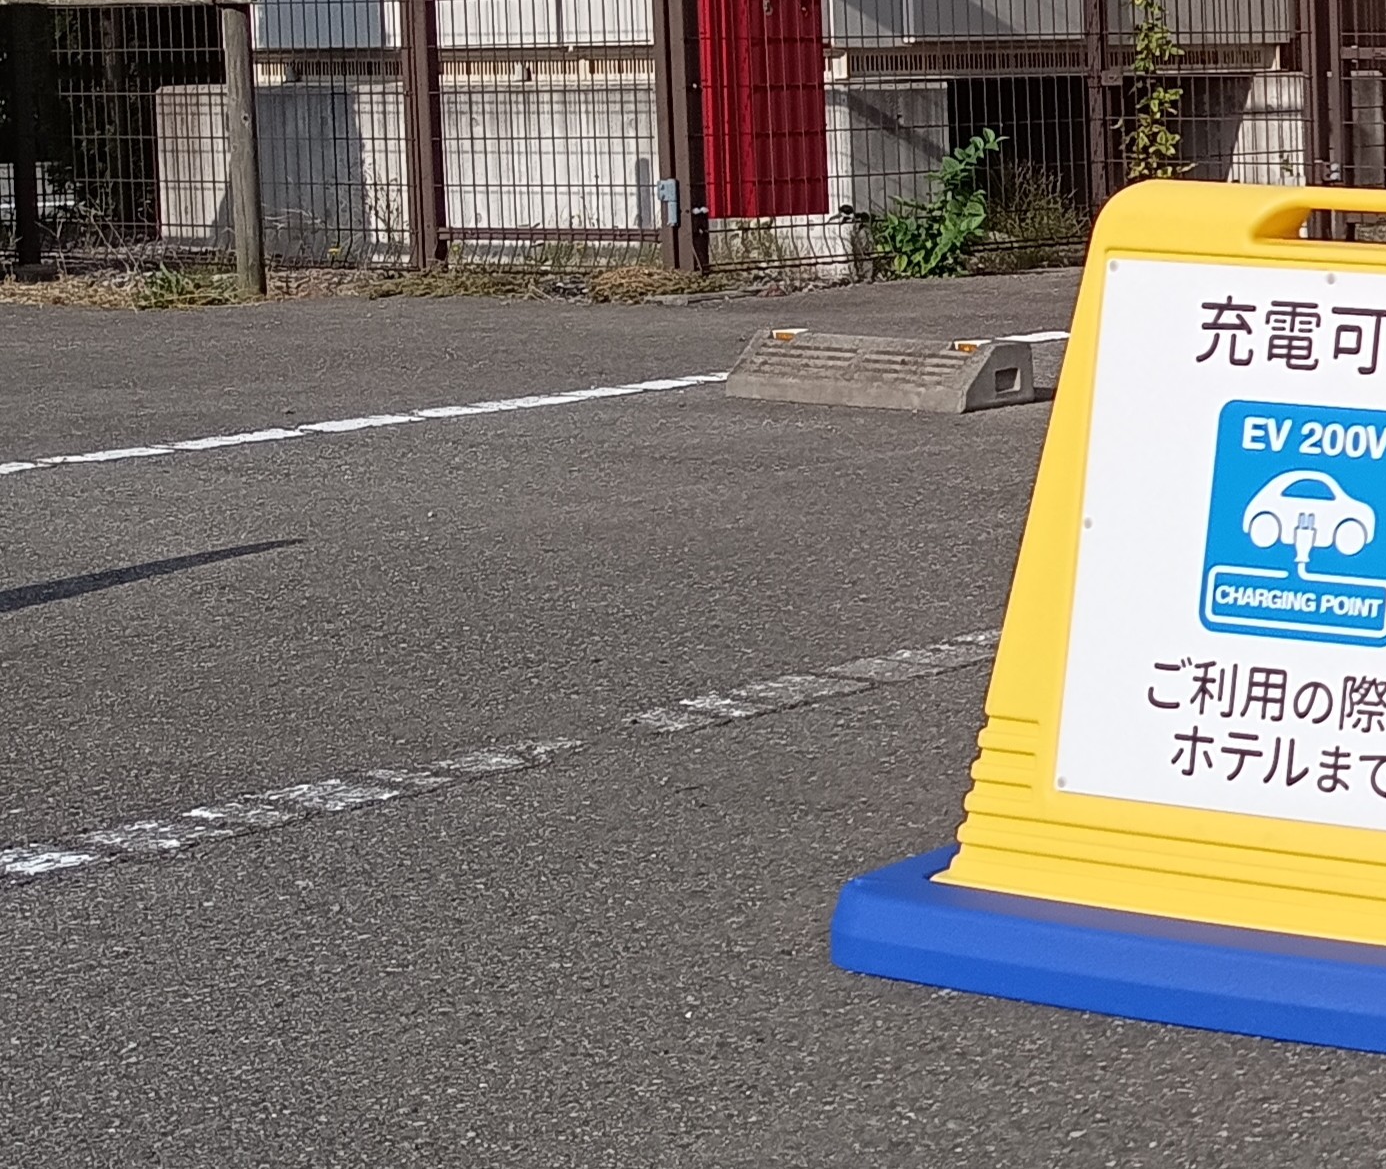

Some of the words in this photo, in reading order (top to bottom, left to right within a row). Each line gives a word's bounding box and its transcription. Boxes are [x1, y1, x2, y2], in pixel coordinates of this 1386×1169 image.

[1241, 416, 1292, 451] EV
[1214, 585, 1317, 613] CHARGING
[1319, 593, 1384, 618] POINT
